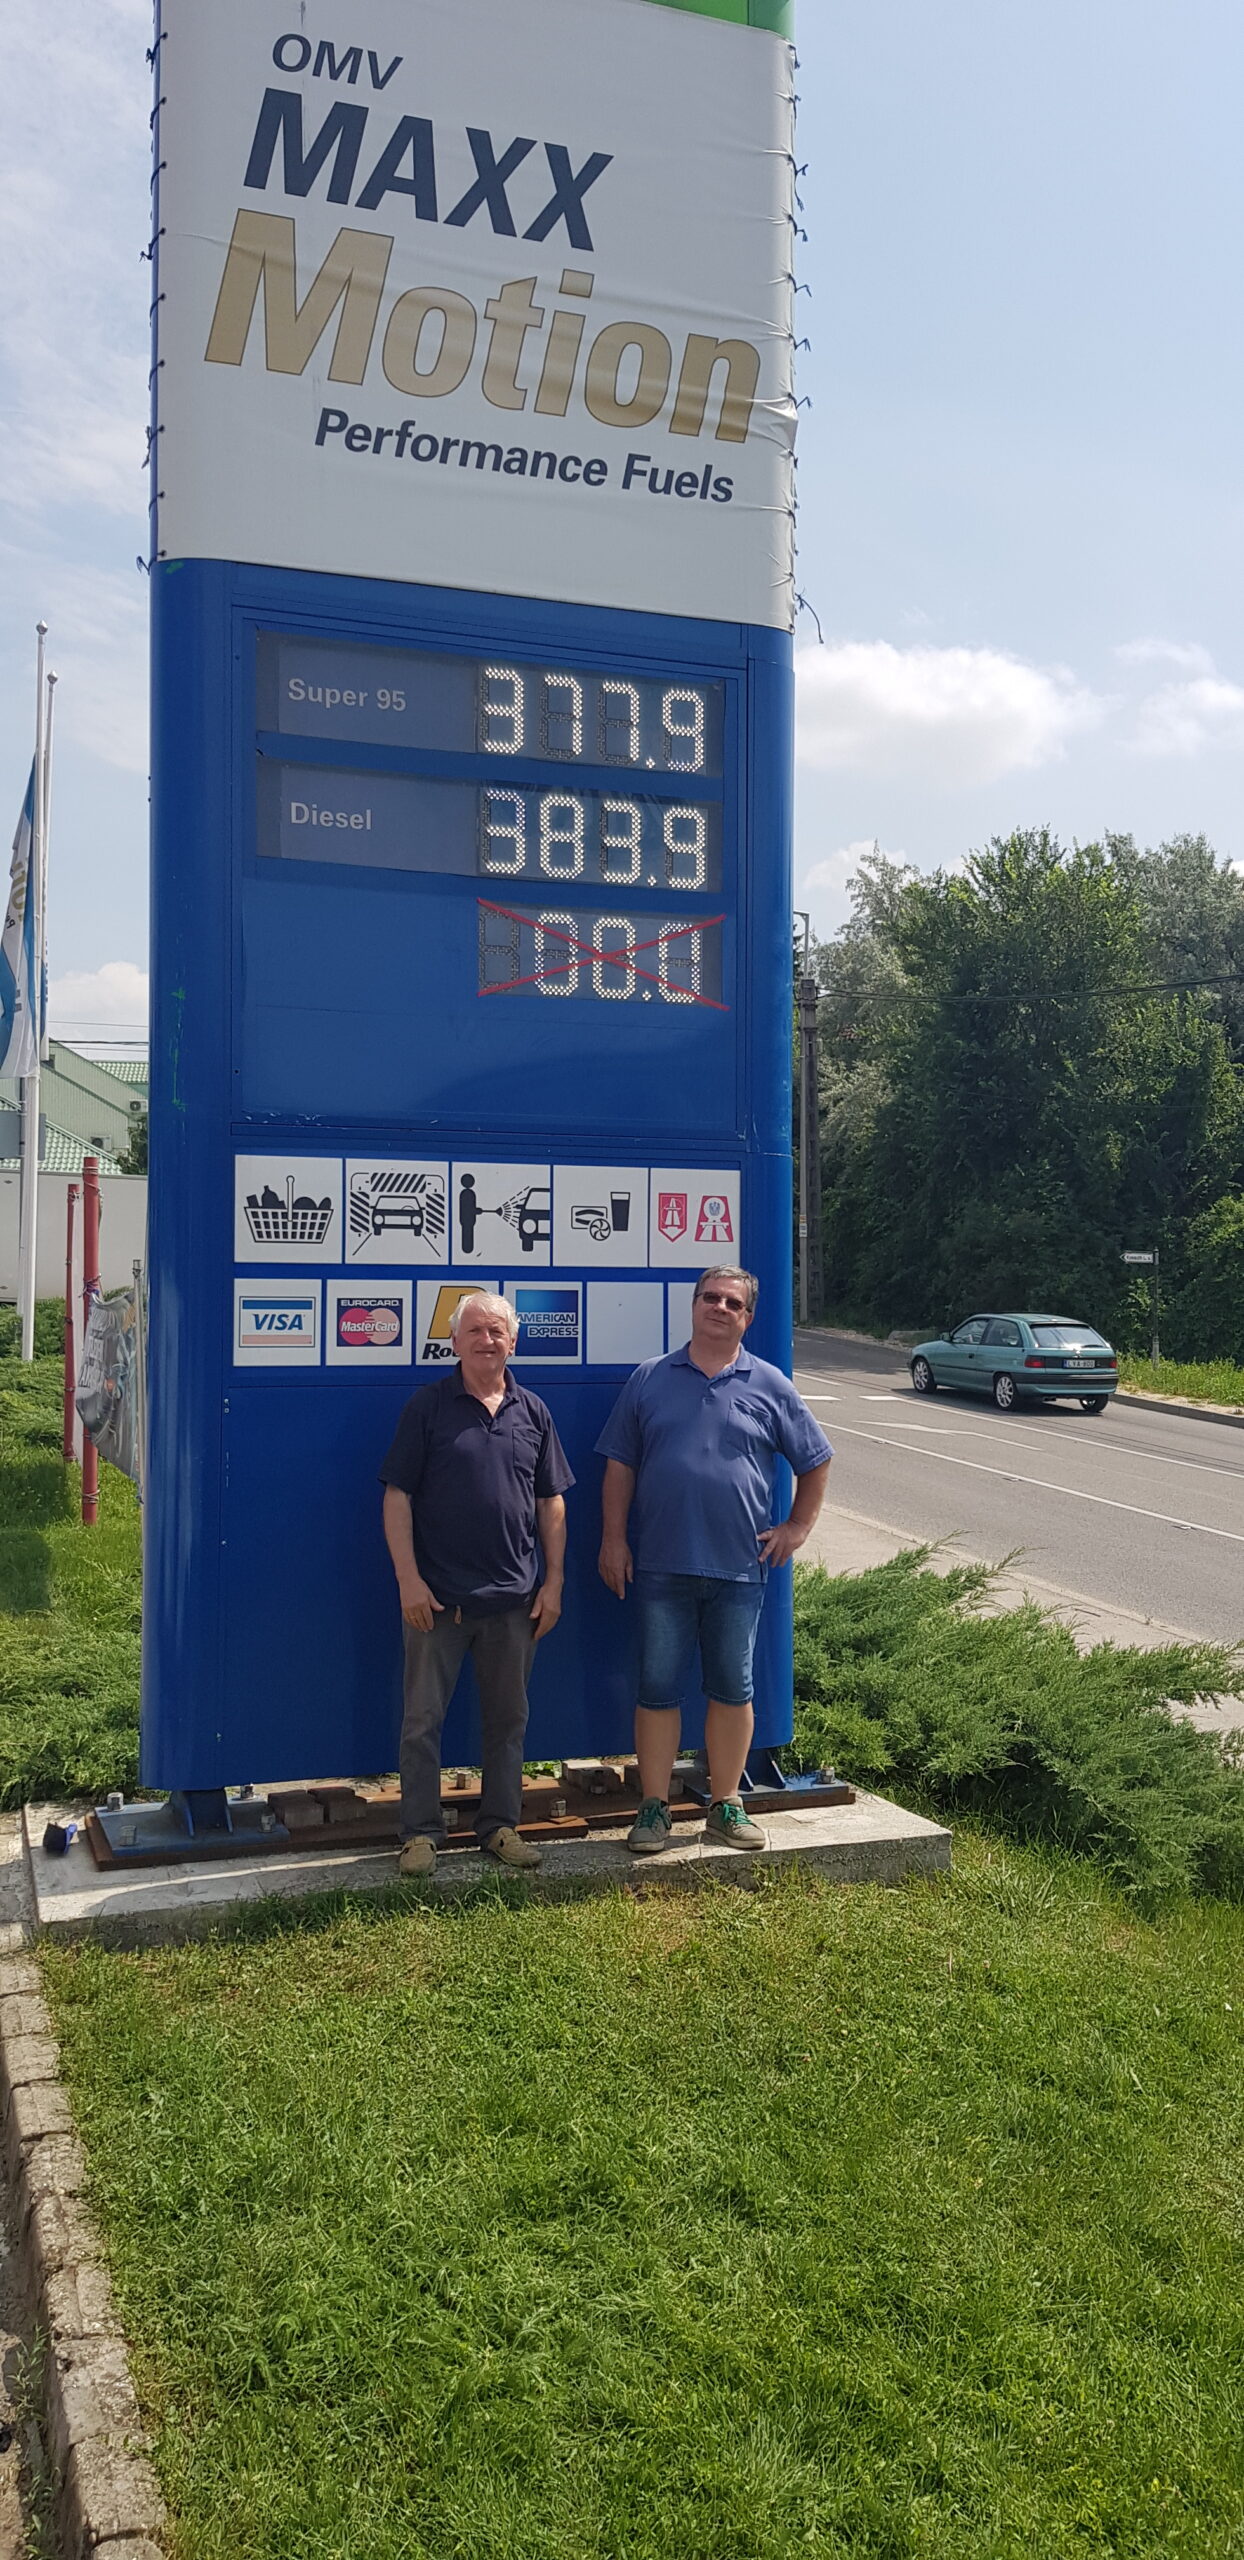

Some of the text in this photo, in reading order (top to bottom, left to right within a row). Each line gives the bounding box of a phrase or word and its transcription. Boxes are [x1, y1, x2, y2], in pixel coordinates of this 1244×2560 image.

[272, 33, 403, 90] OMV
[243, 87, 614, 252] MAXX
[204, 208, 761, 443] Motion
[315, 407, 734, 502] Performance Fuels
[288, 678, 407, 711] Super 95
[481, 666, 705, 773] 377.9
[290, 802, 372, 830] Diesel
[484, 789, 706, 890] 383.9
[340, 1299, 400, 1307] EUROCARD
[517, 1313, 575, 1323] AMERICAN
[252, 1313, 304, 1331] VISA
[340, 1320, 399, 1332] MasterCard
[529, 1327, 579, 1336] EXPRESS
